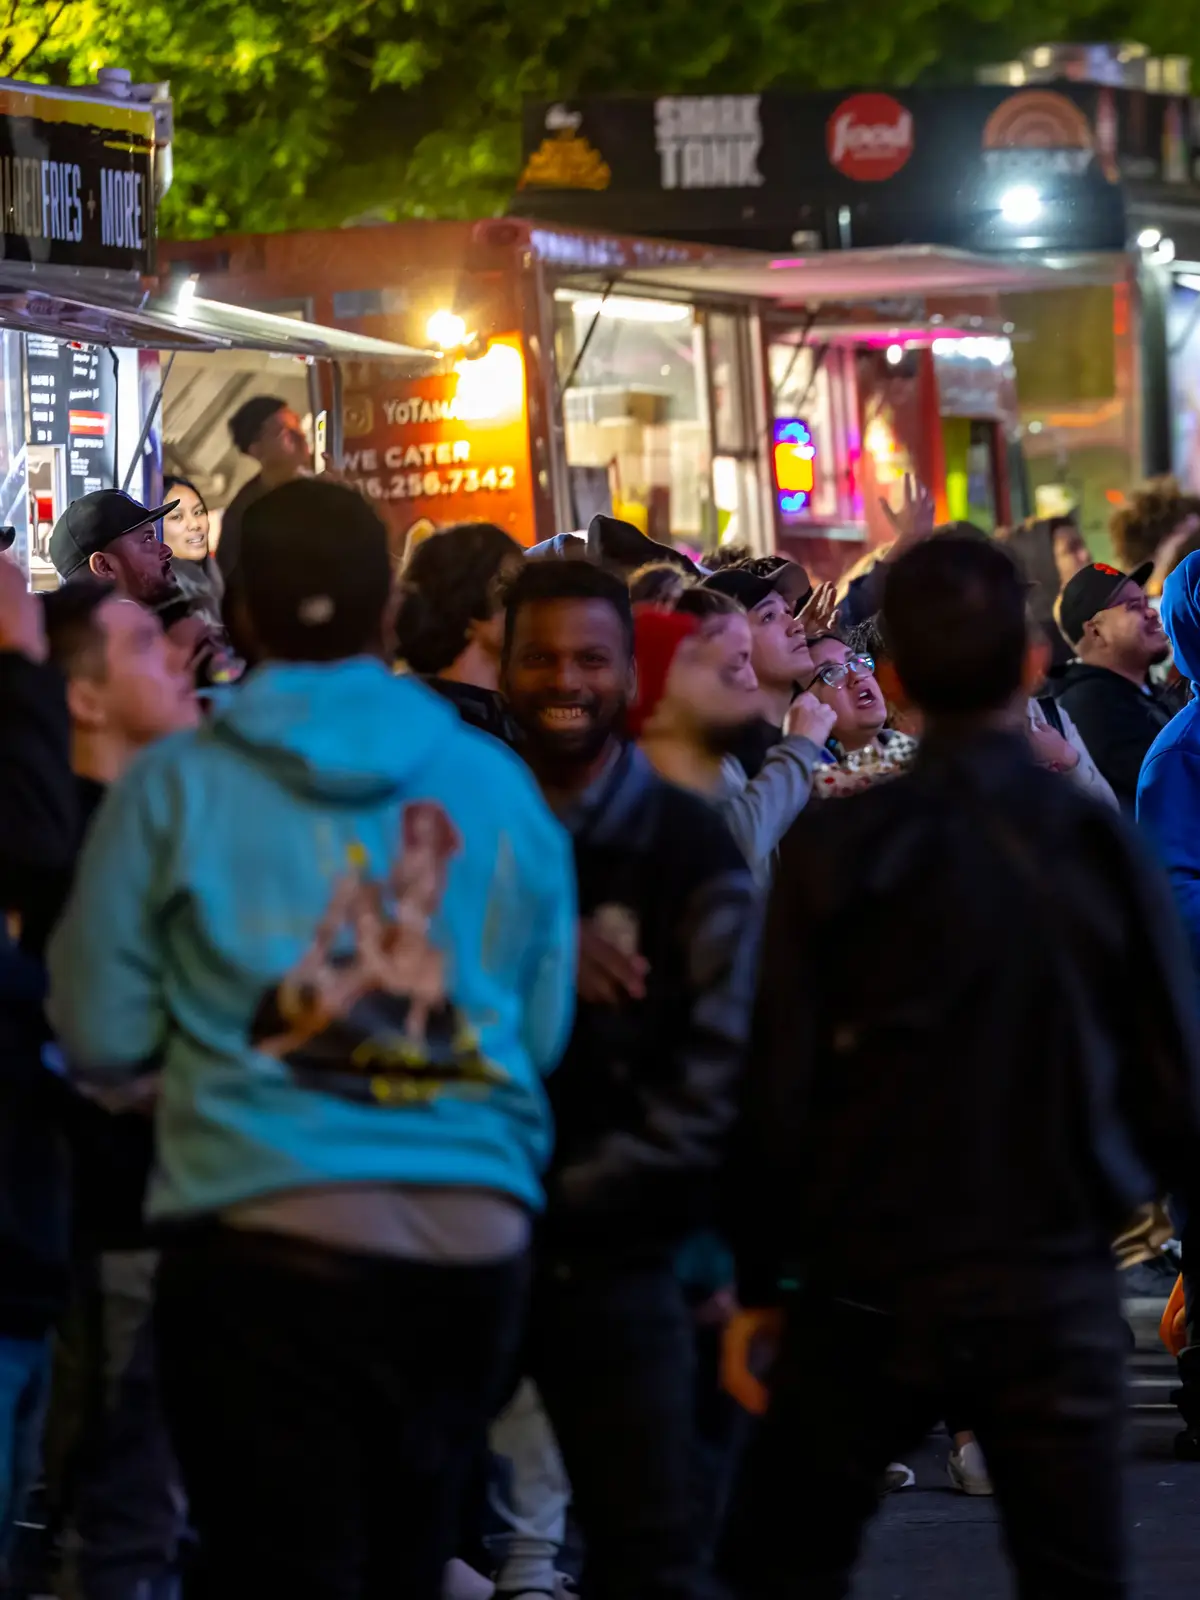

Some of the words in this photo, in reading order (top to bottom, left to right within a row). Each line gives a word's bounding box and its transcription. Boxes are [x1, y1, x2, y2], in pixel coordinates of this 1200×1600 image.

[656, 137, 766, 189] TANK
[0, 155, 41, 238] ADED
[41, 159, 82, 243] FRIES
[342, 449, 377, 472] WE
[385, 440, 470, 468] CATER
